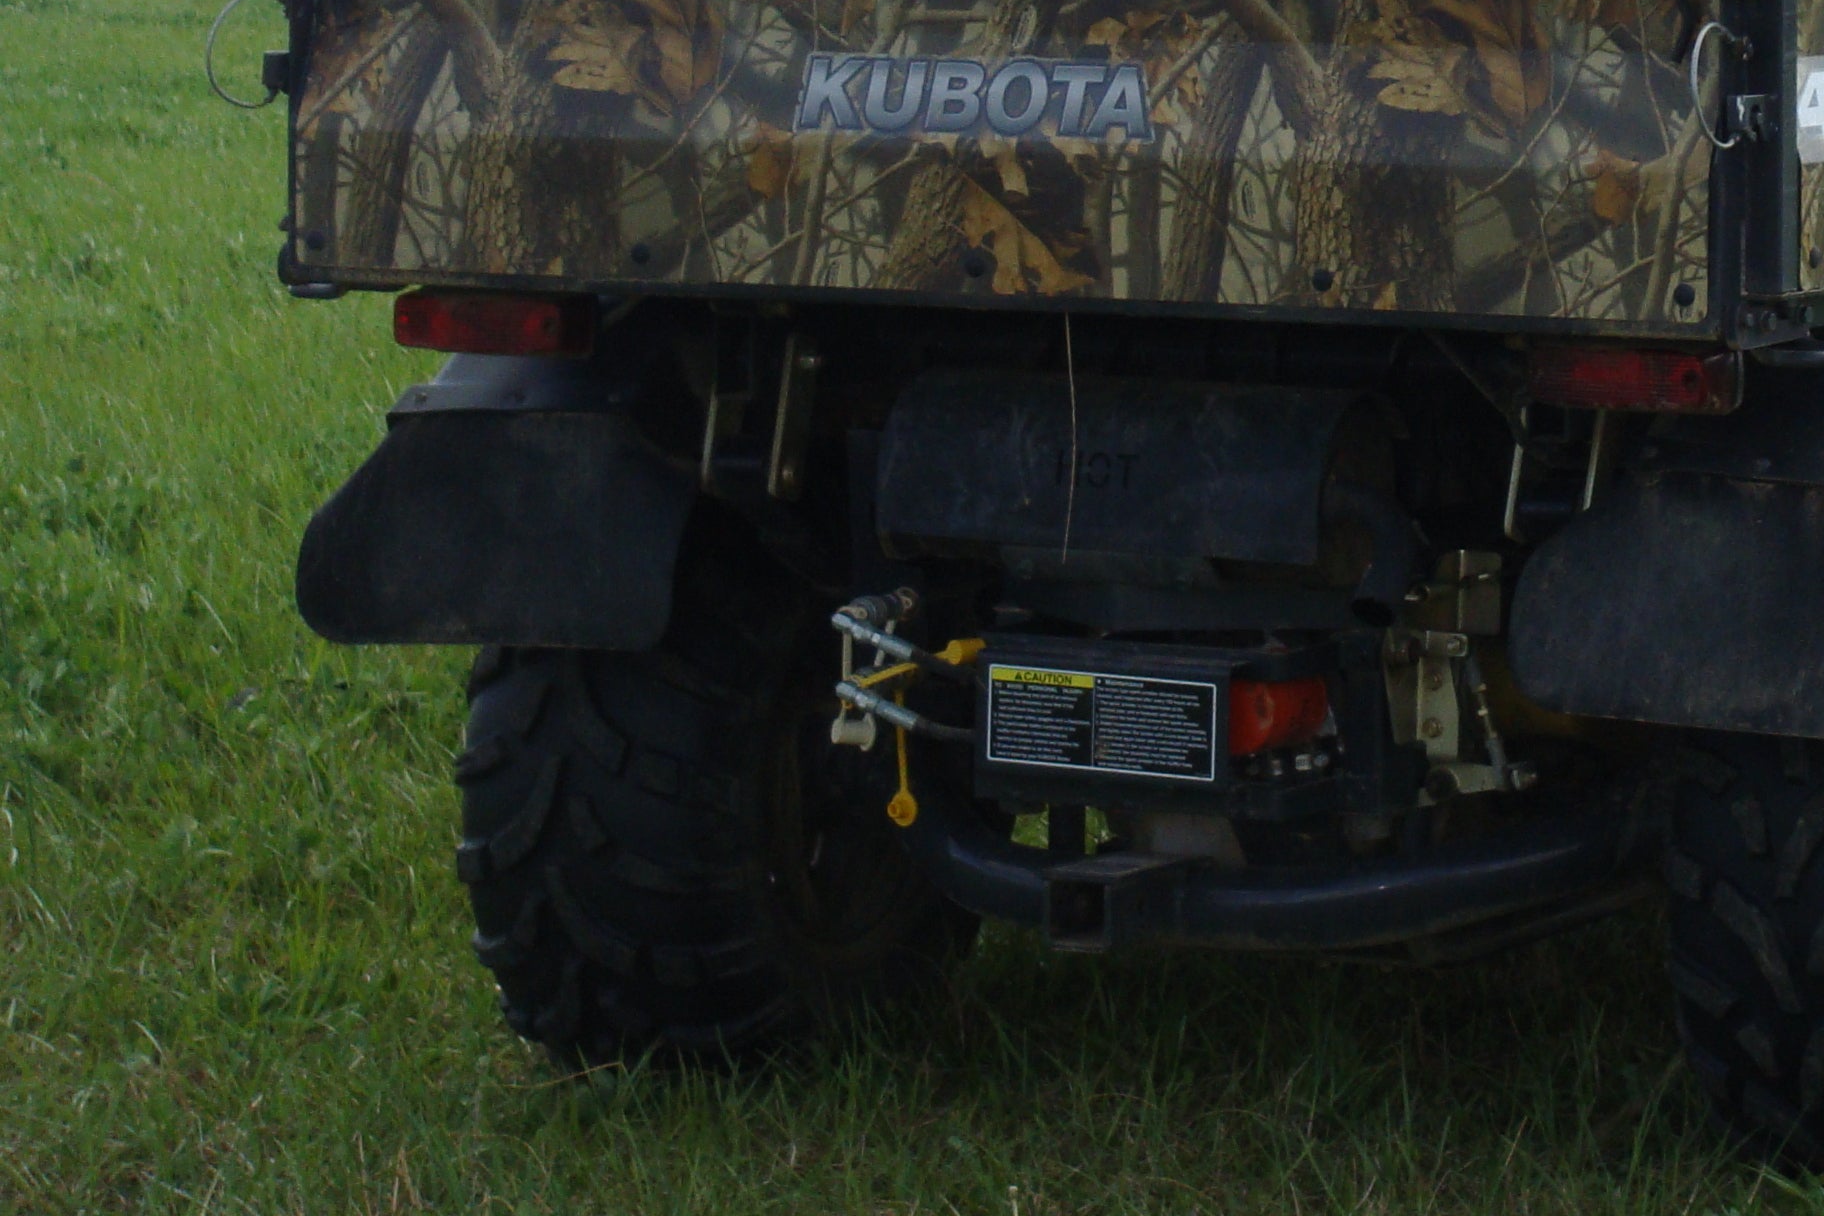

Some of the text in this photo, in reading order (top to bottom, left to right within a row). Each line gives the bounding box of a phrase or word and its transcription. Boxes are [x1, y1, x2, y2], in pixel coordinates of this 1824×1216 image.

[798, 55, 1153, 140] KUBOTA
[1055, 449, 1140, 490] HOT
[1023, 671, 1073, 685] CAUTION
